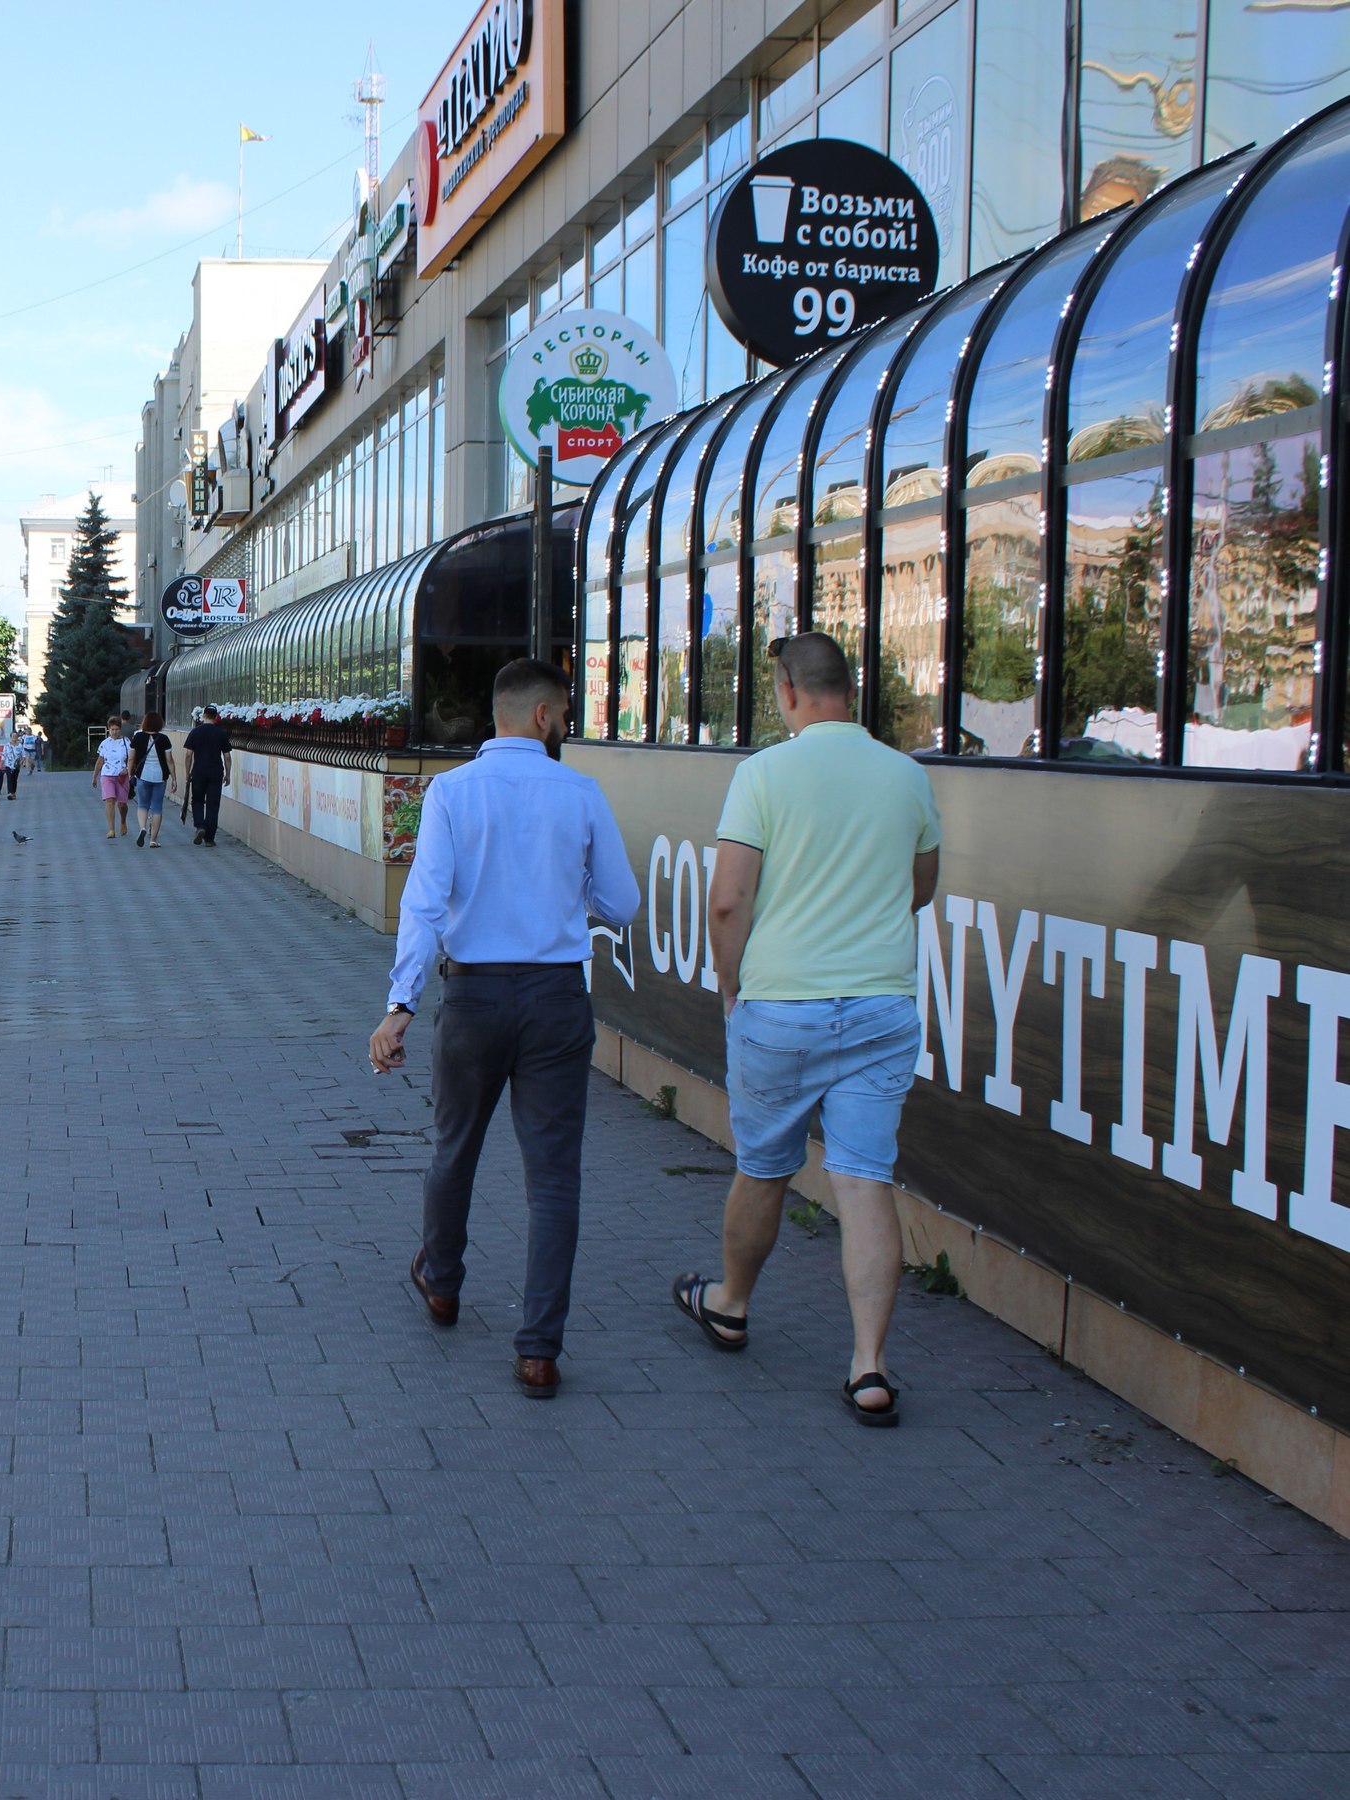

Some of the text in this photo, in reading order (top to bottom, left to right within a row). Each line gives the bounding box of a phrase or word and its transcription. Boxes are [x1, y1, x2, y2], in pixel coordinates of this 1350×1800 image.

[800, 186, 916, 219] Возьми
[797, 218, 919, 251] с собой!
[742, 253, 921, 285] Кофе от бариста
[793, 286, 856, 338] 99
[532, 325, 650, 366] РЕСТОРАН
[550, 385, 626, 404] СИБИРСКАЯ
[560, 402, 616, 422] КОРОНА
[567, 438, 614, 447] СПОРТ
